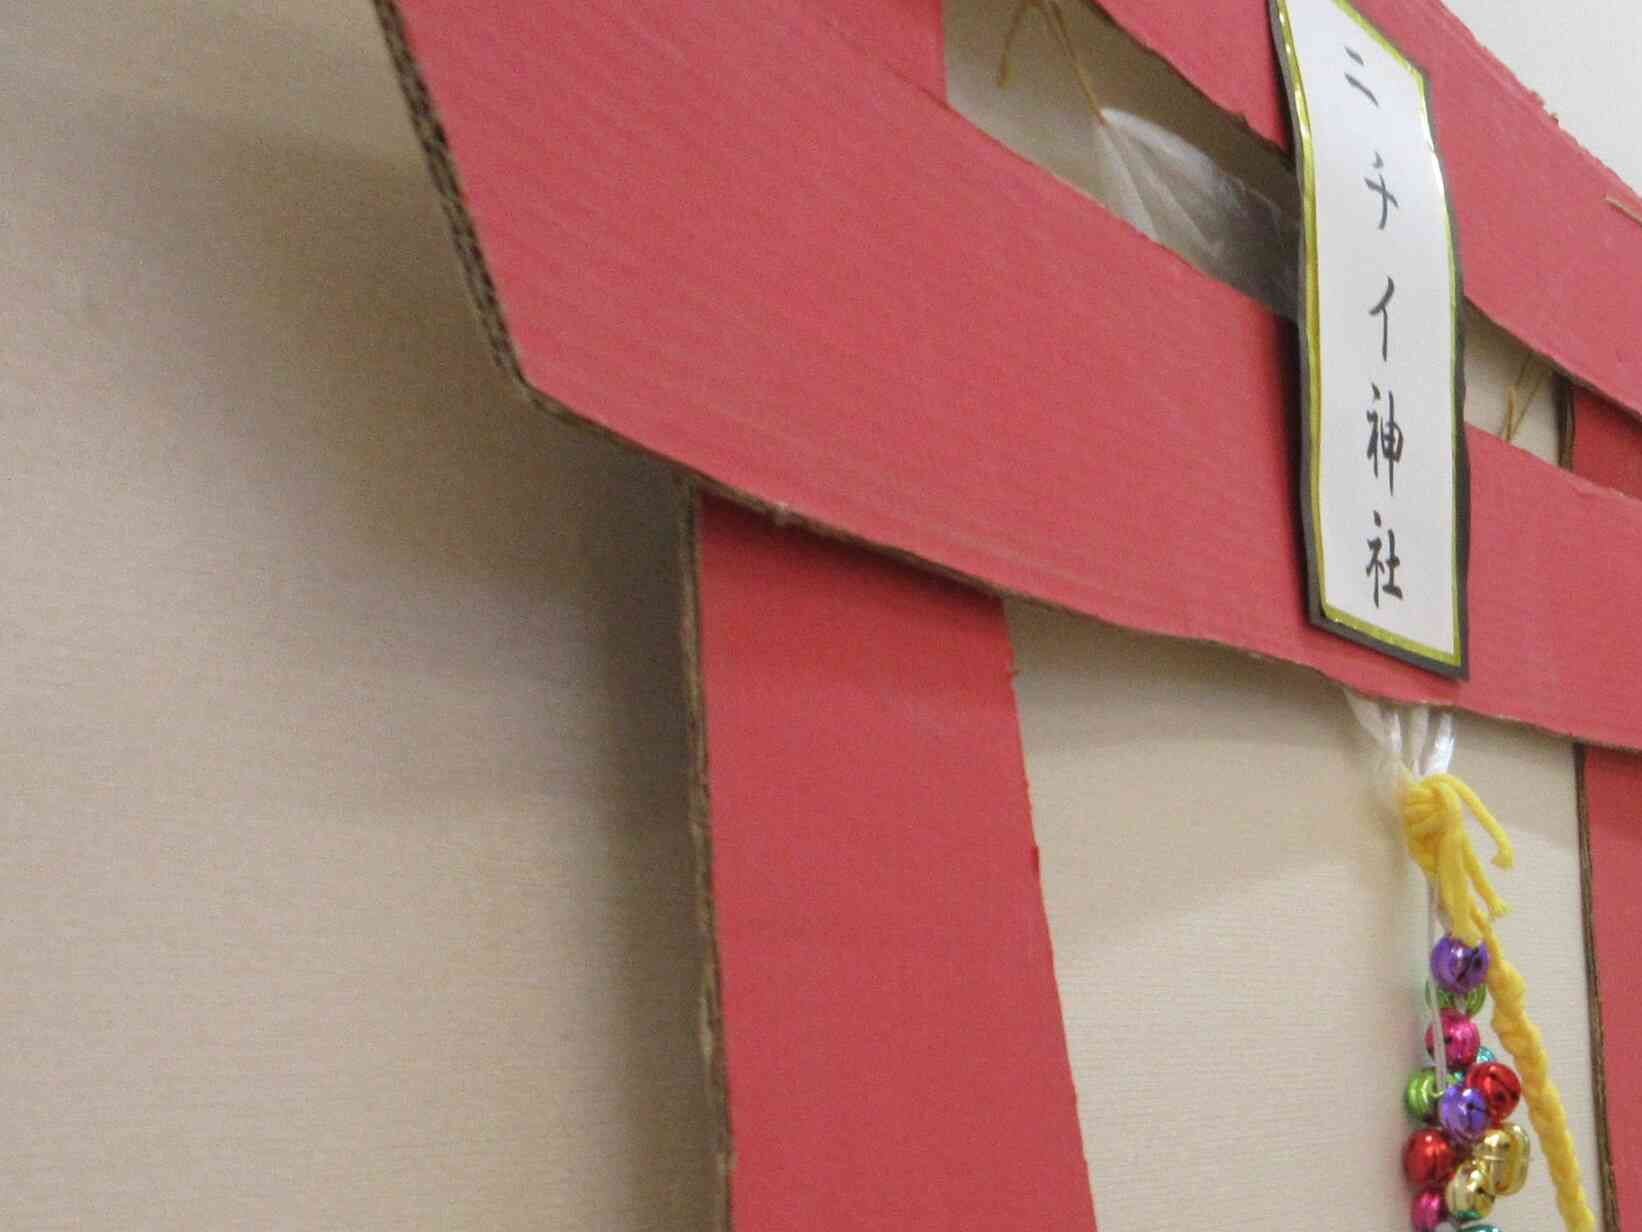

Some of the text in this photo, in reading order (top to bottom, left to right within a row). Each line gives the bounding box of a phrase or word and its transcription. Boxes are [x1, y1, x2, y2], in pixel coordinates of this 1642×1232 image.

[1344, 46, 1405, 609] ニチイ神社
